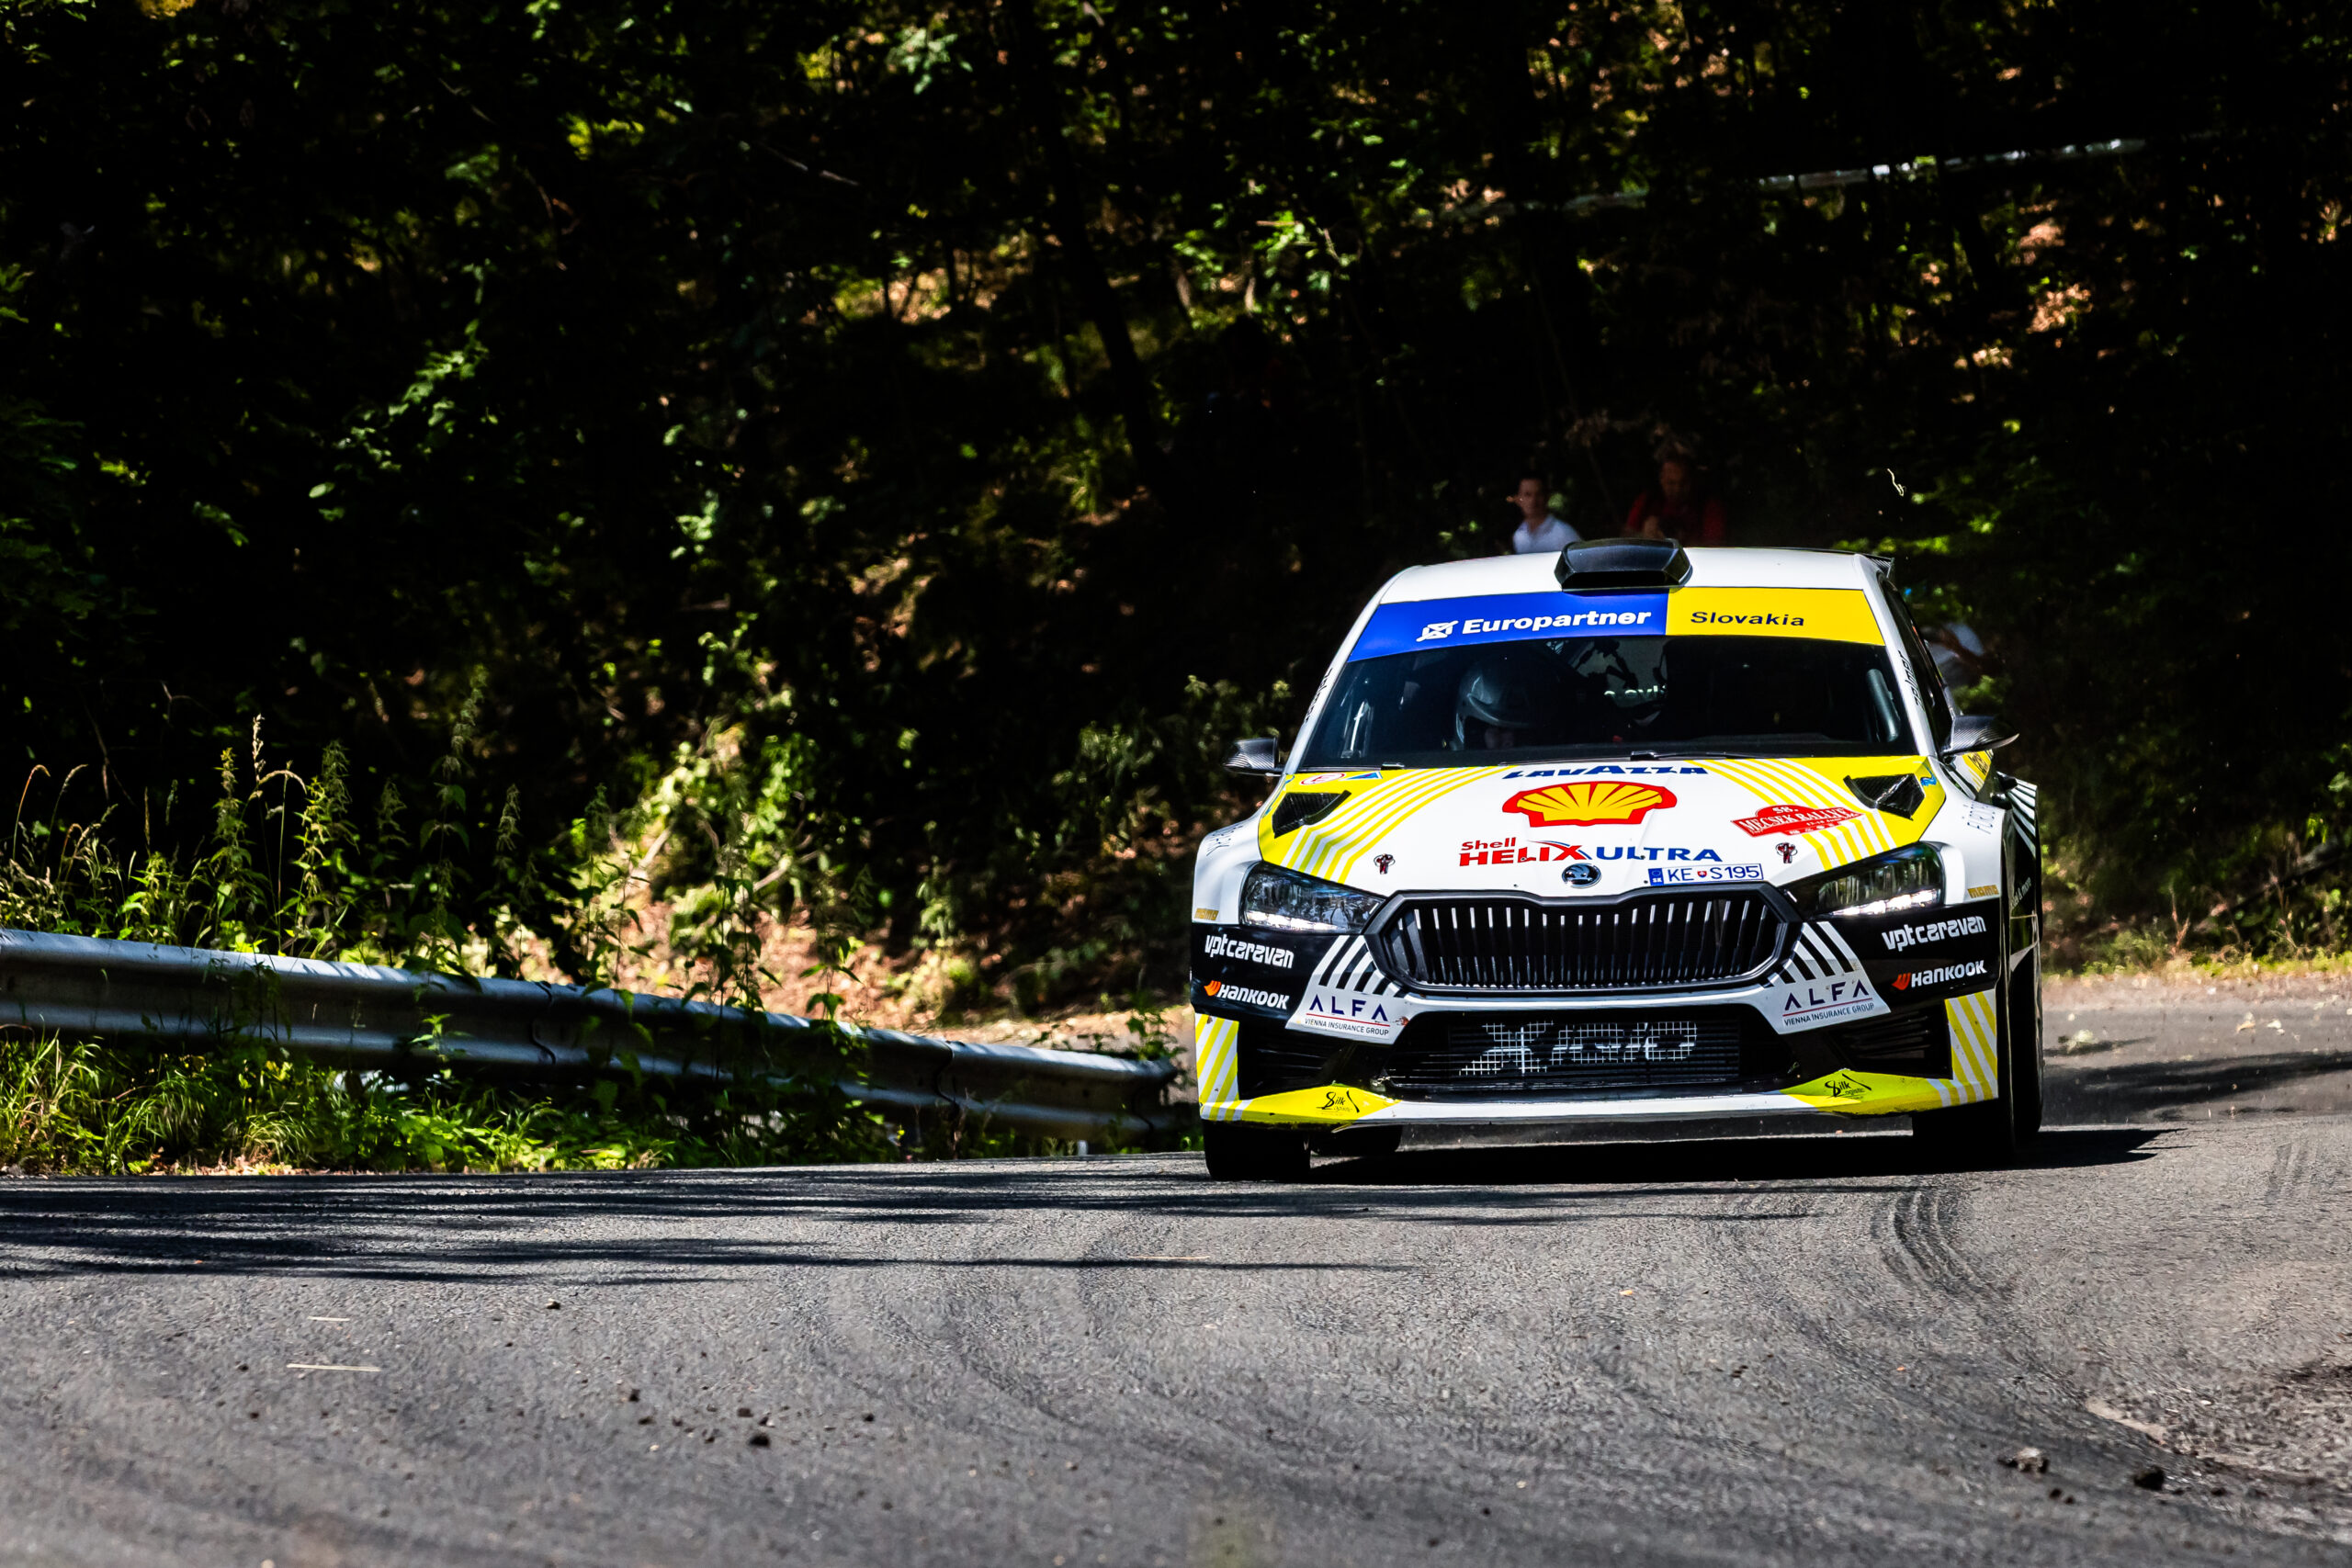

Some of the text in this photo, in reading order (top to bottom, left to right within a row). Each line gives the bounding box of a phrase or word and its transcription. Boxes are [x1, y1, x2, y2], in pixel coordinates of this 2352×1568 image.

[1462, 610, 1652, 634] Europartner
[1690, 611, 1804, 626] Slovakia
[1502, 765, 1708, 780] LAVAZZA
[1459, 841, 1724, 866] HELIX ULTRA
[1461, 837, 1516, 851] Shell
[1668, 865, 1759, 882] KE S195
[1784, 979, 1870, 1011] ALFA
[1308, 993, 1388, 1021] ALFA
[1784, 1002, 1874, 1026] VIENNA INSURANCE GROUP
[1305, 1018, 1389, 1036] VIENNA INSURANCE GROUP
